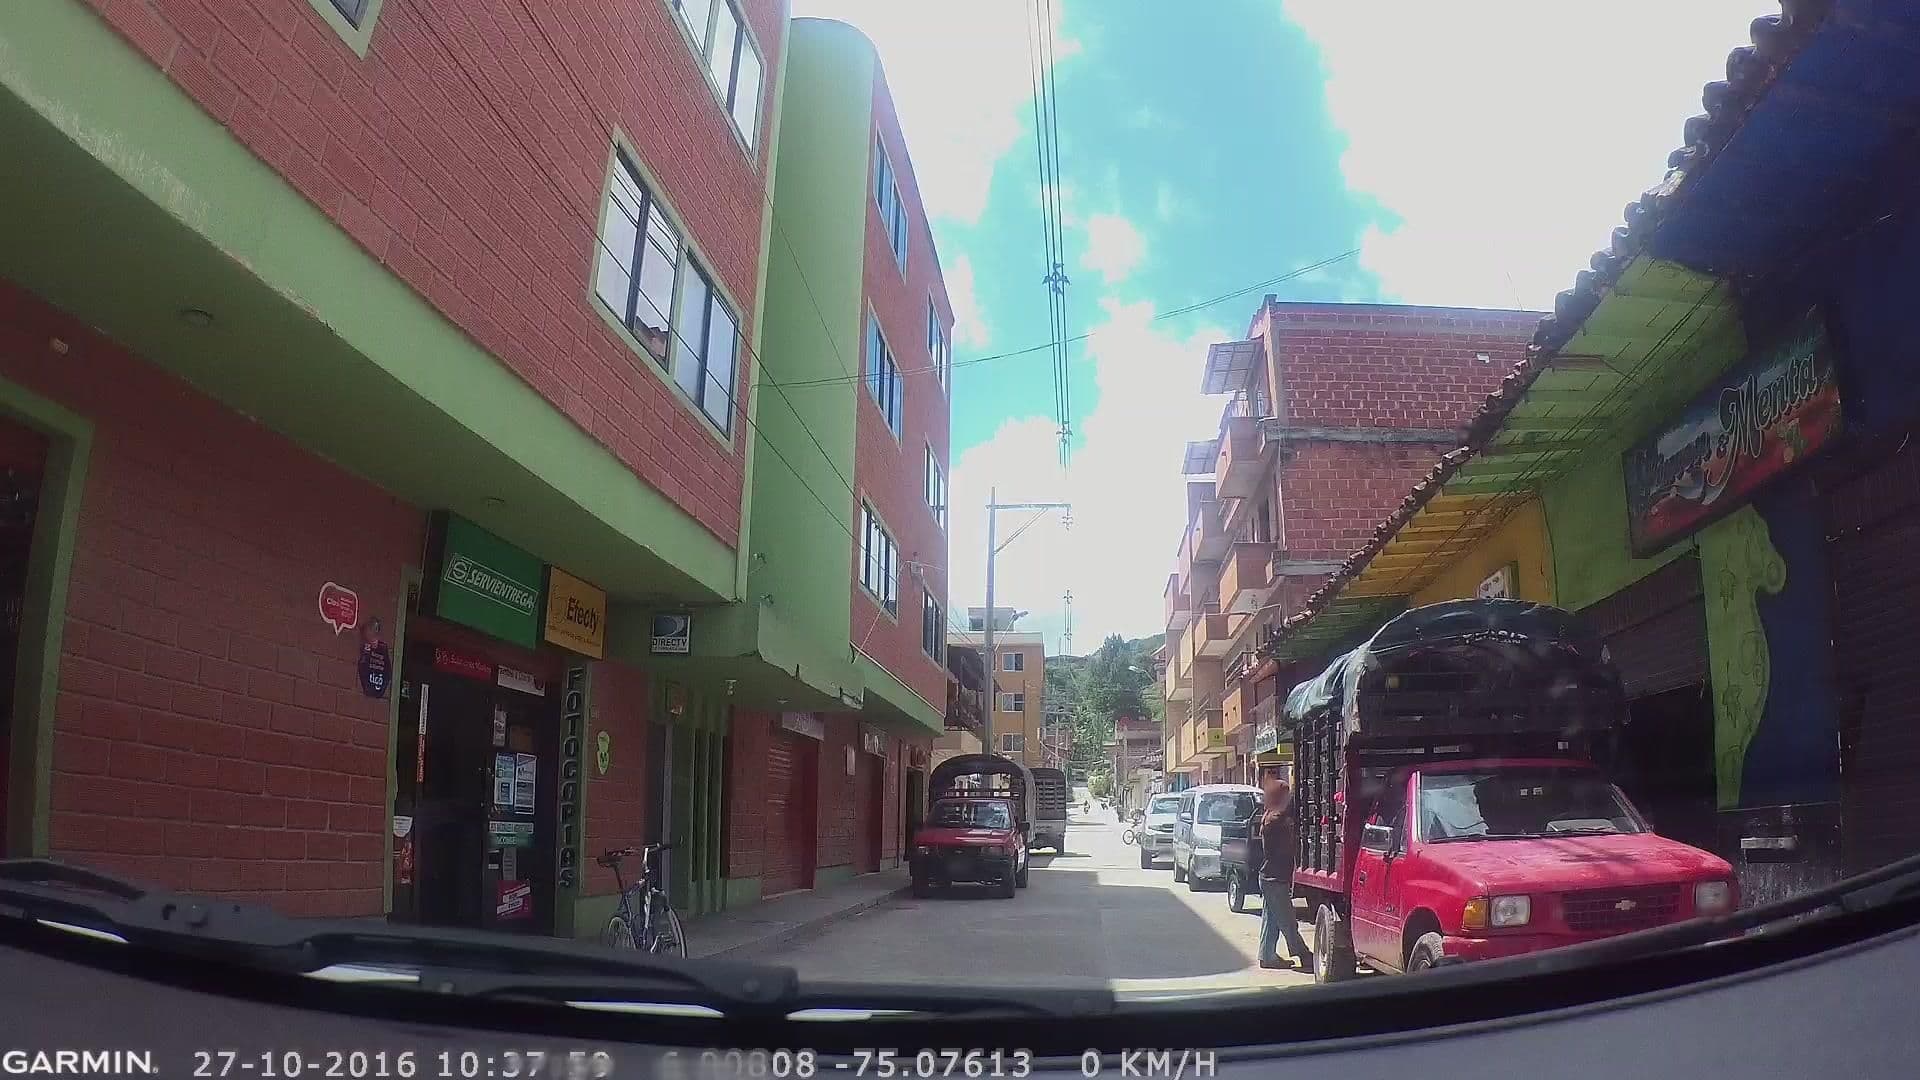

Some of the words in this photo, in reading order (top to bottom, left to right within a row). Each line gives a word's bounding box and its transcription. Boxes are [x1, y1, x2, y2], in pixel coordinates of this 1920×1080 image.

[466, 569, 537, 609] SERVIENTREGA
[566, 597, 599, 635] Efecty
[652, 638, 688, 647] DIRECTV
